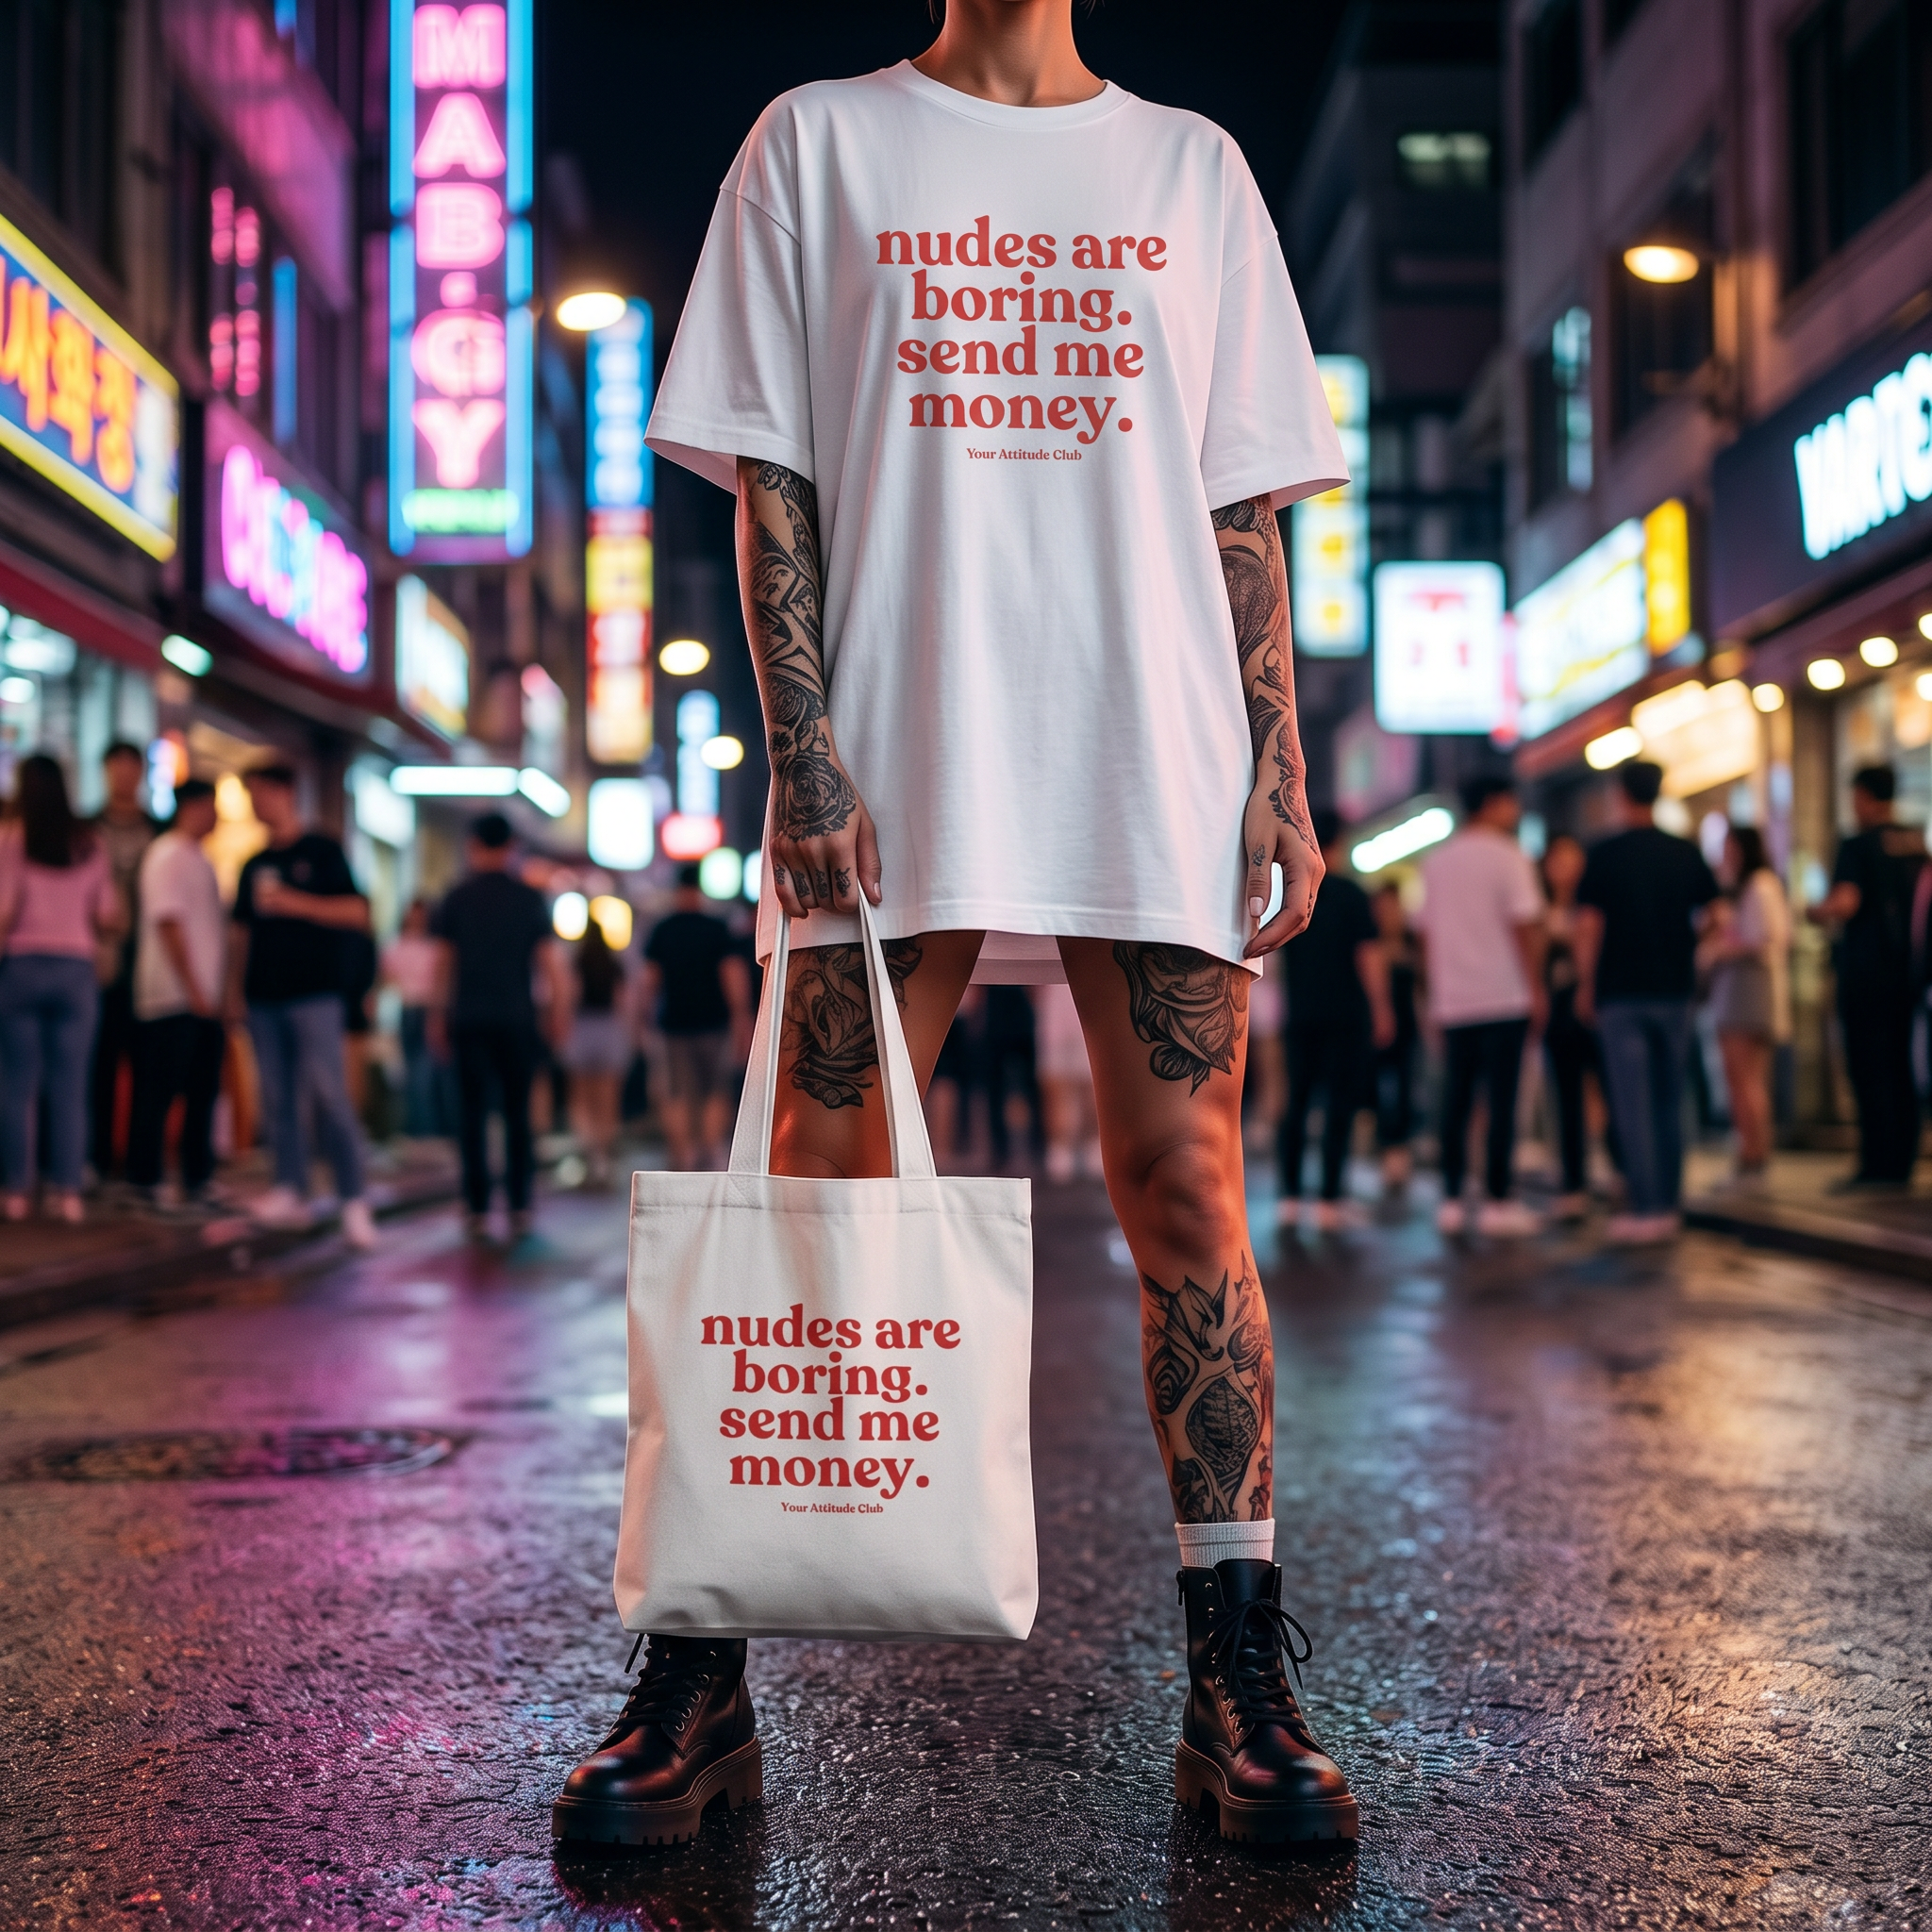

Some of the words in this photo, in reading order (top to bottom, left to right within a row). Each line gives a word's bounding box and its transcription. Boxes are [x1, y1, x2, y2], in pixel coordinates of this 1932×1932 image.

[876, 215, 1058, 269] nudes
[1072, 234, 1168, 272] are
[911, 269, 1133, 333] boring.
[897, 325, 1039, 375] send
[1054, 342, 1144, 378] me
[908, 393, 1134, 445] money.
[966, 448, 996, 459] Your
[998, 447, 1050, 460] Attitude
[1053, 449, 1083, 461] Club
[700, 1303, 862, 1349] nudes
[874, 1319, 961, 1350] are
[732, 1348, 928, 1404] boring.
[719, 1396, 845, 1441] send
[858, 1411, 940, 1441] me
[729, 1455, 930, 1500] money.
[781, 1502, 808, 1513] Your
[810, 1503, 856, 1514] Attitude
[858, 1504, 884, 1514] Club
